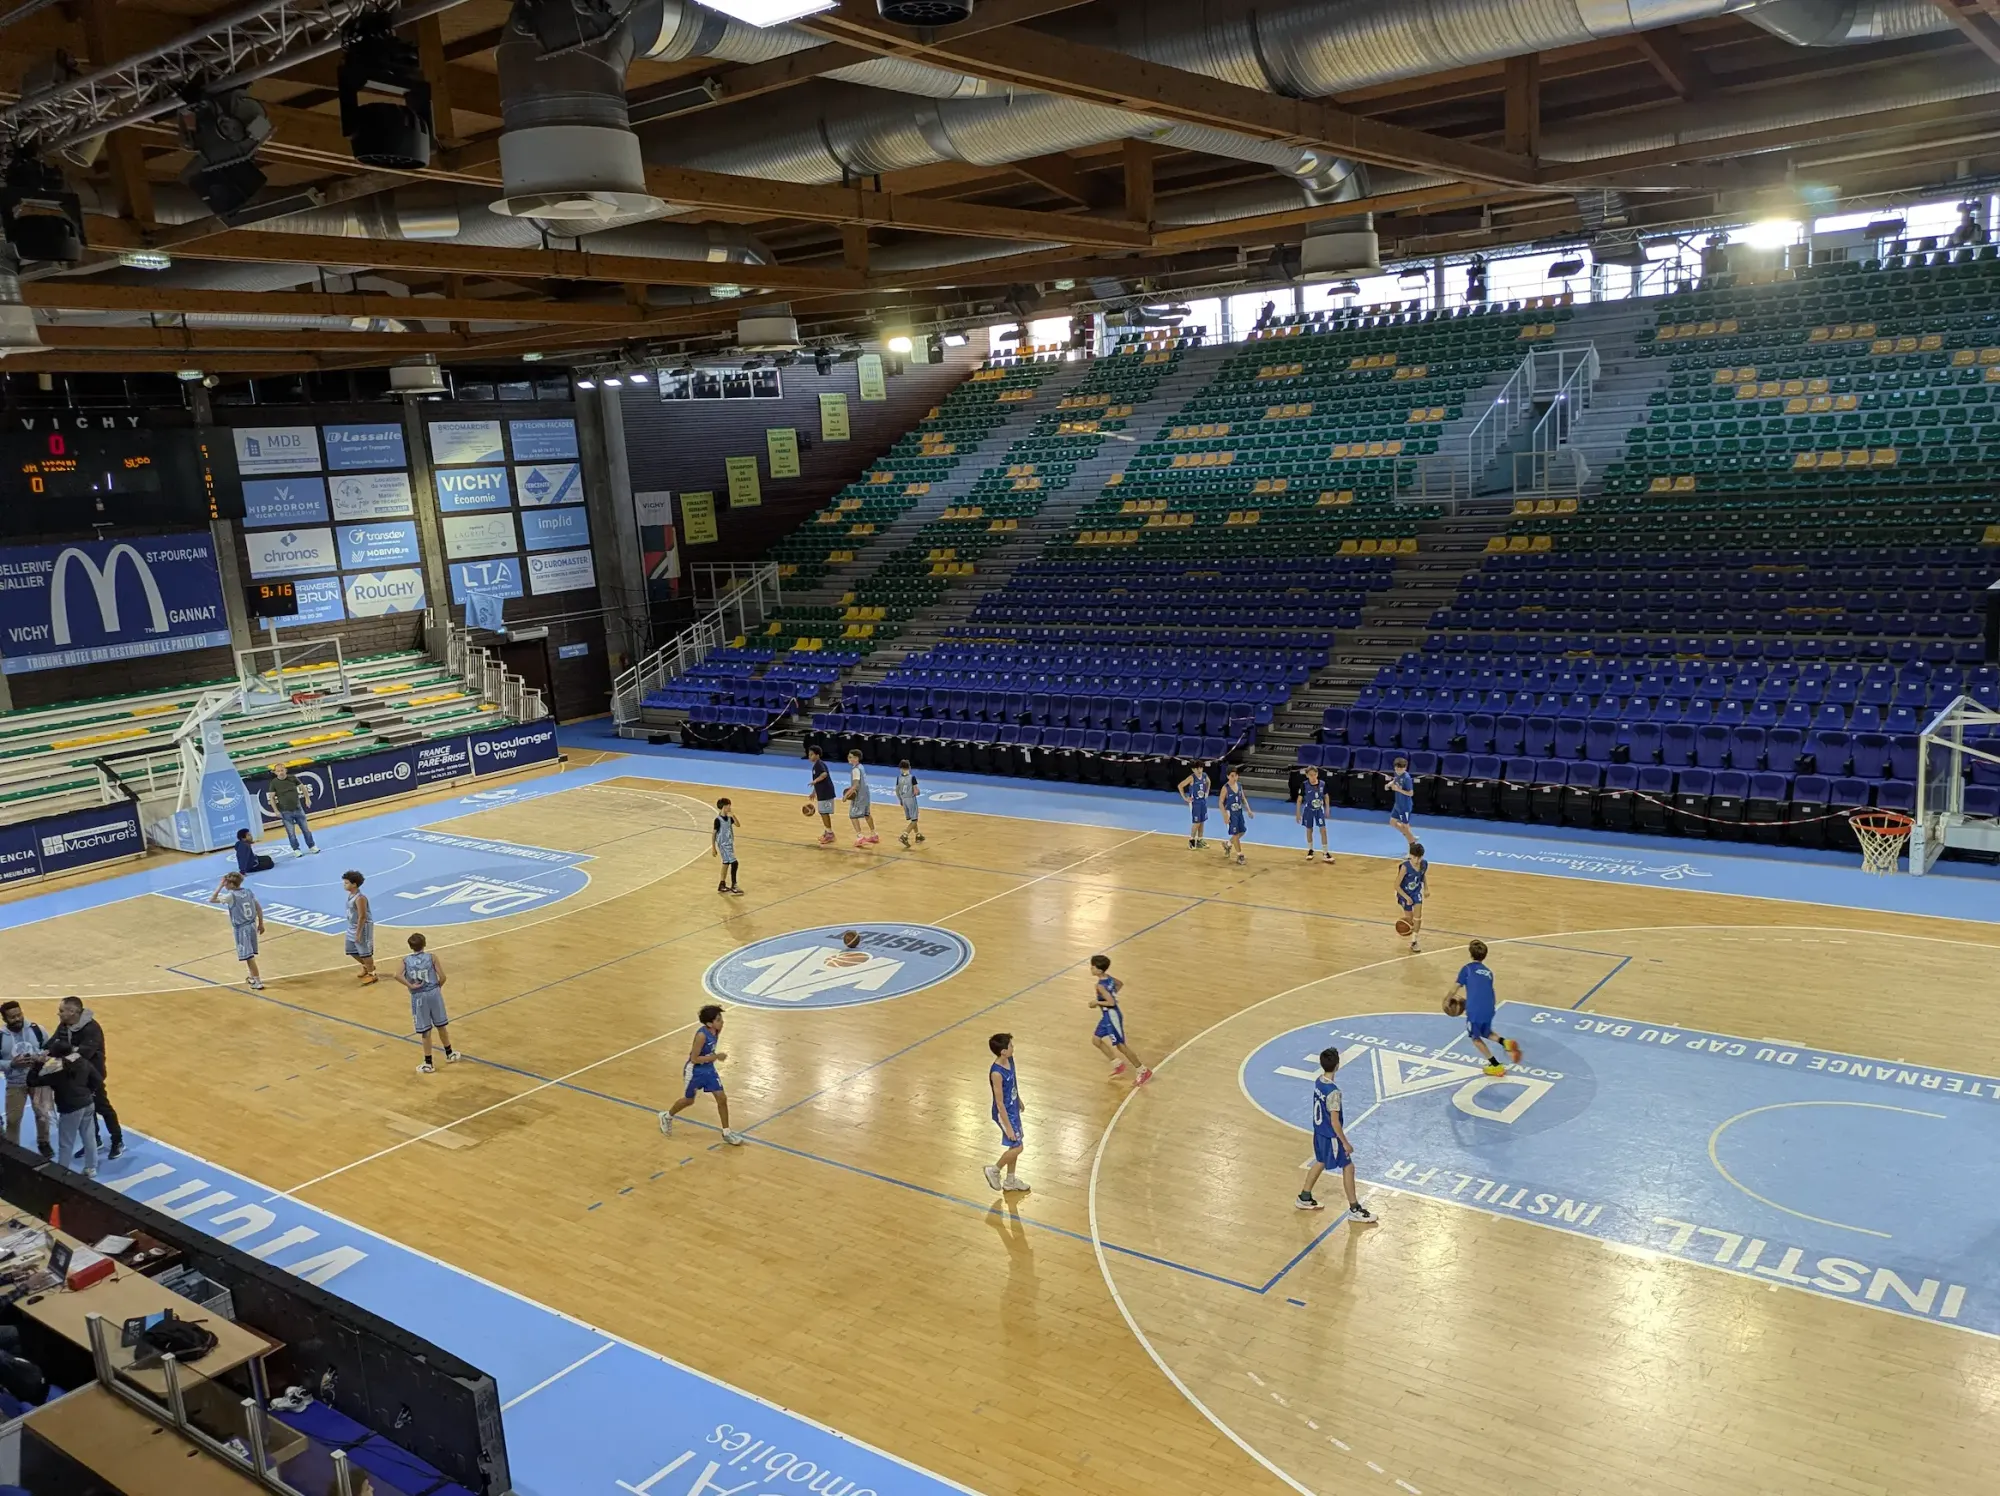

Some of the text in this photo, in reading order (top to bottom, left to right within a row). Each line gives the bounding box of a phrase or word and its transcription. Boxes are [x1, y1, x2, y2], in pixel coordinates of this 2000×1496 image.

[21, 416, 139, 430] VICHY
[49, 434, 64, 455] 0
[268, 434, 301, 448] MDB
[342, 432, 401, 442] Lassalle
[31, 477, 44, 492] 0
[441, 474, 502, 491] VICHY
[454, 493, 496, 505] Économie
[248, 502, 321, 513] HIPPODROME
[538, 515, 572, 530] implid
[366, 530, 405, 541] transdev
[146, 548, 208, 563] ST-POURÇAIN
[264, 548, 319, 563] chronos
[544, 556, 588, 569] EUROMASTER
[462, 560, 512, 588] LTA
[260, 584, 292, 598] 9:16
[298, 590, 339, 603] BRUN
[354, 582, 415, 600] ROUCHY
[169, 606, 216, 623] GANNAT
[9, 624, 49, 642] VICHY
[27, 653, 64, 669] TRIBUNE
[65, 649, 90, 664] HÔTEL
[110, 640, 160, 658] RESTAURANT
[161, 639, 171, 651] LE
[171, 637, 194, 650] PATIO
[491, 730, 552, 752] boulanger
[419, 745, 451, 758] FRANCE
[494, 749, 517, 761] Vichy
[418, 751, 466, 769] PARE-BRISE
[337, 770, 394, 790] E.Leclerc
[64, 829, 129, 852] Machuret
[0, 849, 35, 864] ENCIA
[1474, 849, 1637, 872] BOURBONNAIS
[3, 867, 36, 879] MEUBLÉES
[1568, 863, 1646, 876] ALLIER
[243, 902, 253, 919] 6
[1574, 1018, 1632, 1038] BAC
[1347, 1031, 1390, 1047] TOIT
[1637, 1028, 1680, 1046] AU
[1395, 1042, 1428, 1054] EN
[1686, 1039, 1746, 1057] CAP
[1430, 1049, 1564, 1080] CONANCE
[1754, 1048, 1798, 1066] DU
[1384, 1159, 1602, 1227] INSTILL.FR
[1652, 1216, 1966, 1318] INSTILL
